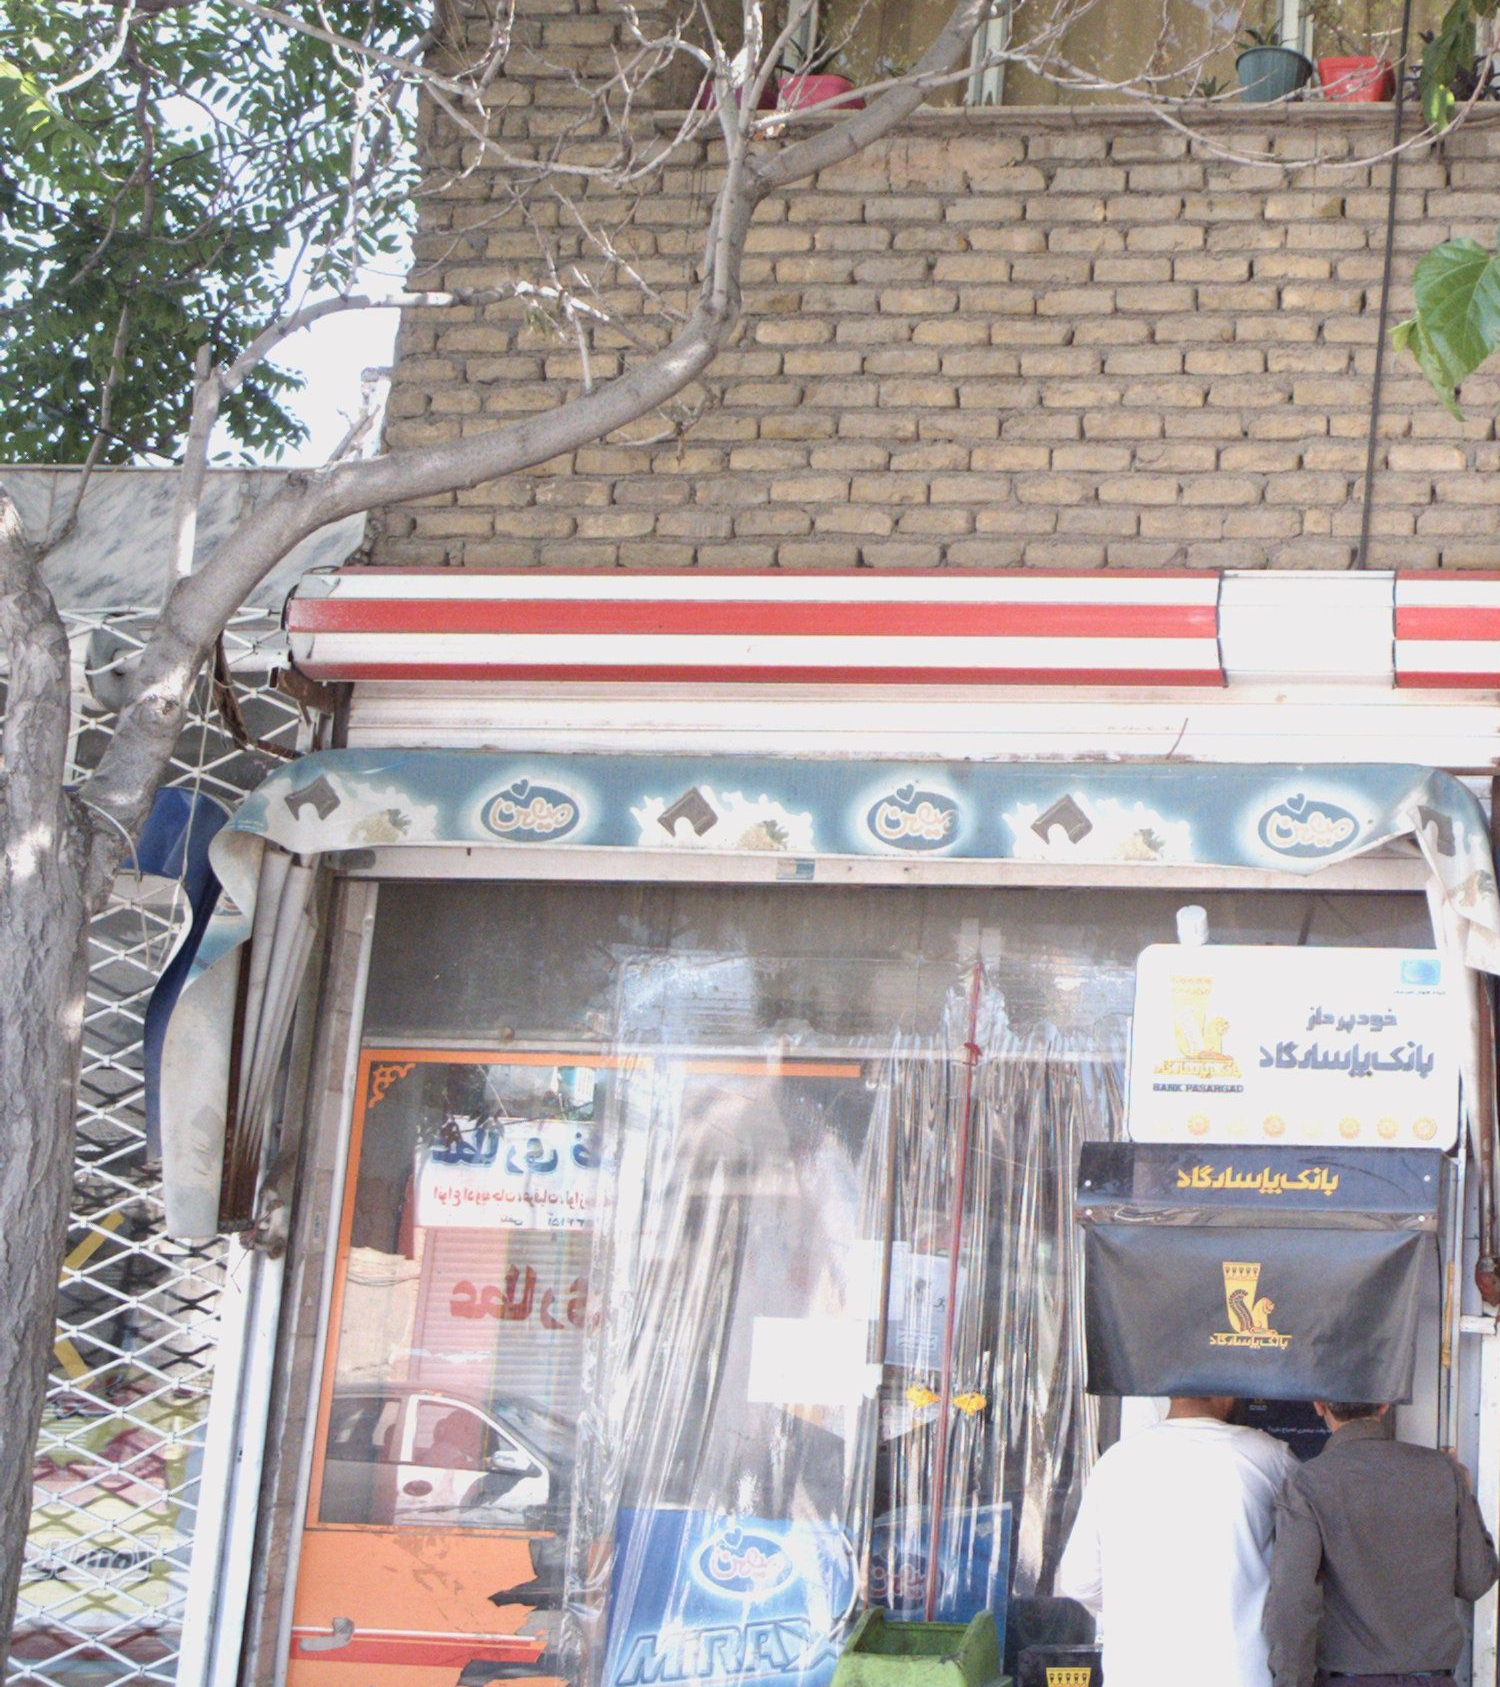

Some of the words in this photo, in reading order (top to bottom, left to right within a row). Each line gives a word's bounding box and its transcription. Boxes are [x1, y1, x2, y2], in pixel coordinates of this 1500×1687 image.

[489, 797, 574, 833] میهن
[876, 801, 958, 839] میهن
[1266, 811, 1355, 848] میهن
[1306, 1005, 1398, 1033] خودپرداز
[1259, 1041, 1373, 1078] پاسارگاد
[1371, 1040, 1434, 1079] بانک
[1152, 1083, 1182, 1092] BANK
[1185, 1083, 1244, 1093] PASARGAD
[1176, 1164, 1282, 1196] پاسارگاد
[1280, 1166, 1340, 1197] بانک
[709, 1544, 787, 1582] میهن
